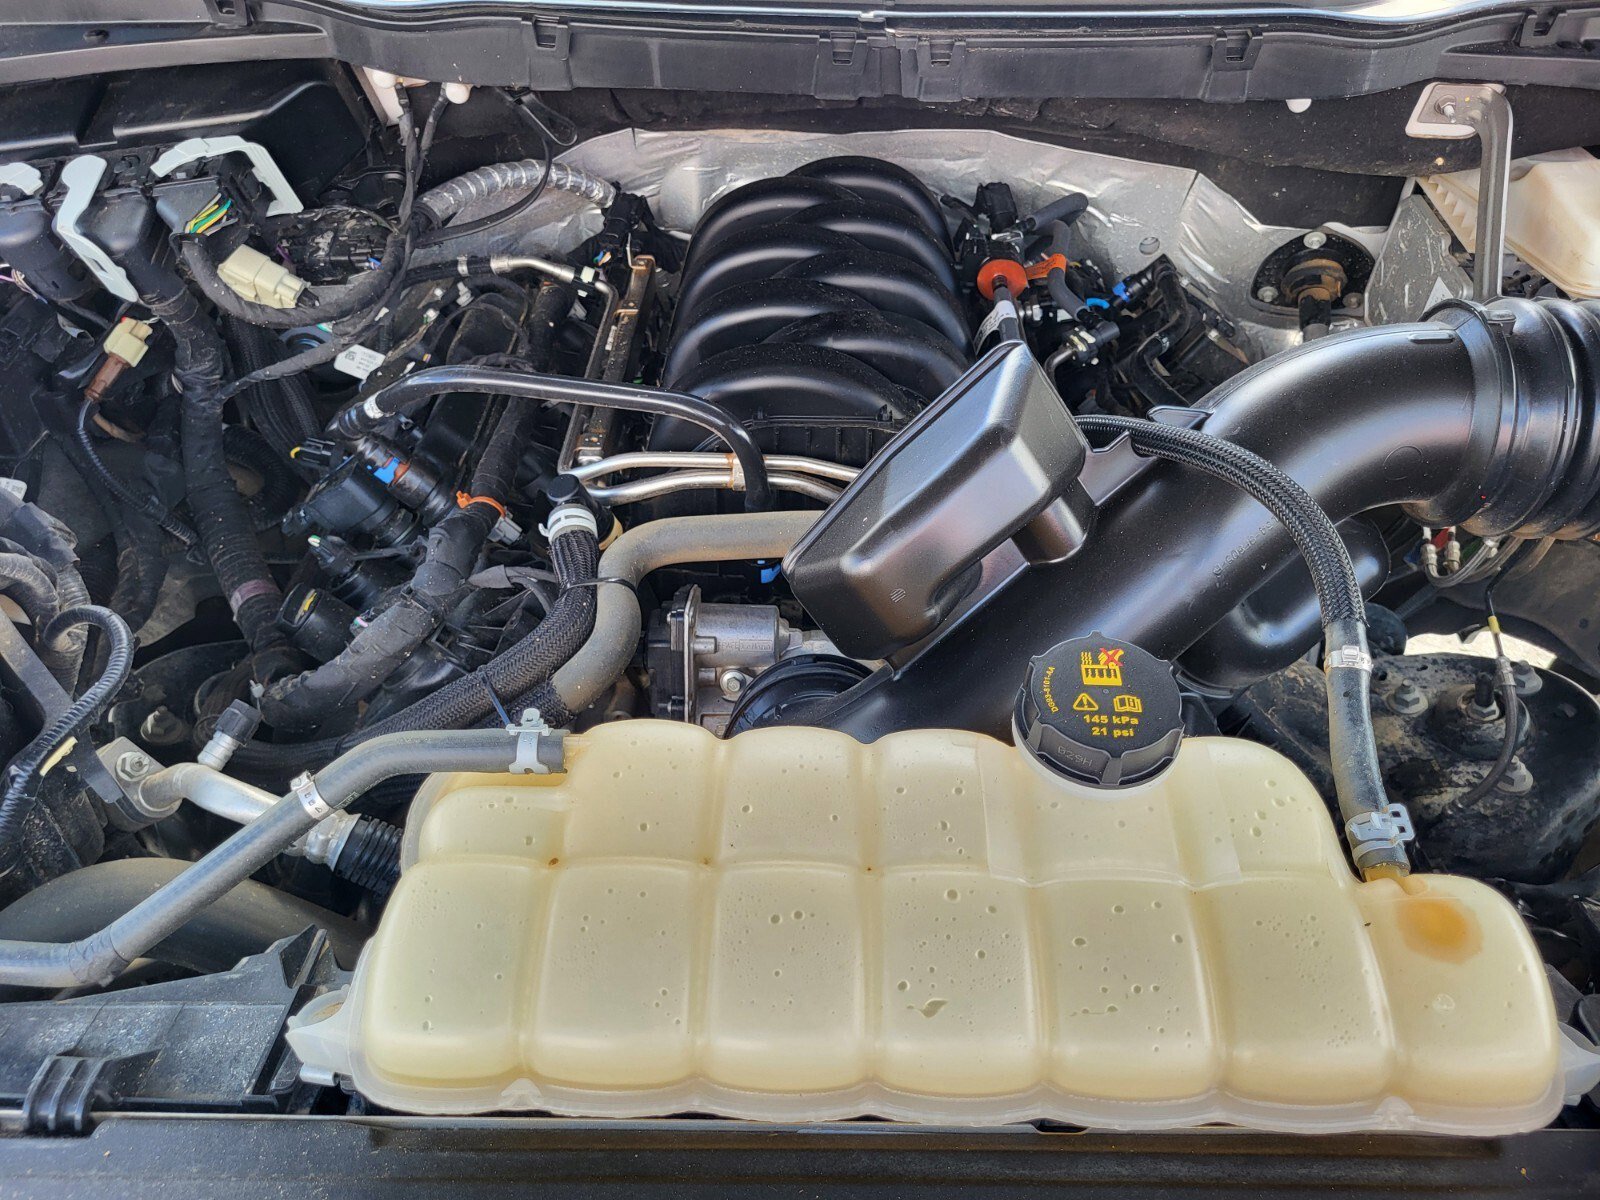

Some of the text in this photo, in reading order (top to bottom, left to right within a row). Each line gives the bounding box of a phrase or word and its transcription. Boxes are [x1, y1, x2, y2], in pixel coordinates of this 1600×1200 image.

[1083, 714, 1139, 725] 145 kPa
[1091, 726, 1135, 738] 21 psi
